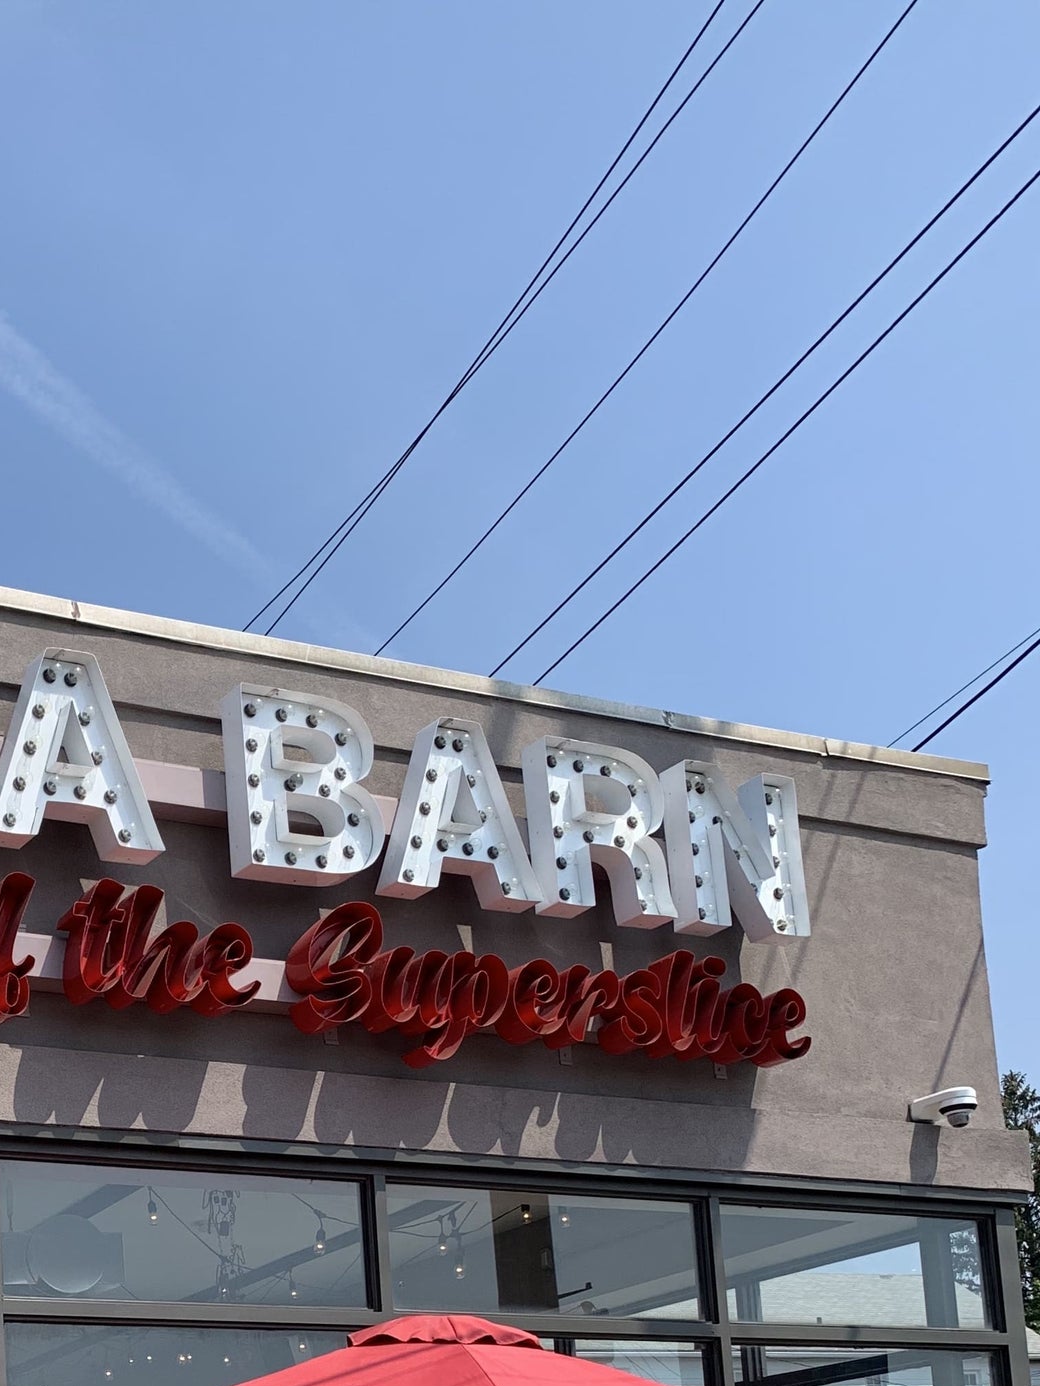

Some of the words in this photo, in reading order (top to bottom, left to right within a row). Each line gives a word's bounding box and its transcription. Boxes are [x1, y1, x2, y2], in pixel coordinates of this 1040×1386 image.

[221, 682, 811, 945] BARN
[57, 877, 262, 1018] the
[286, 901, 813, 1068] Superslice
